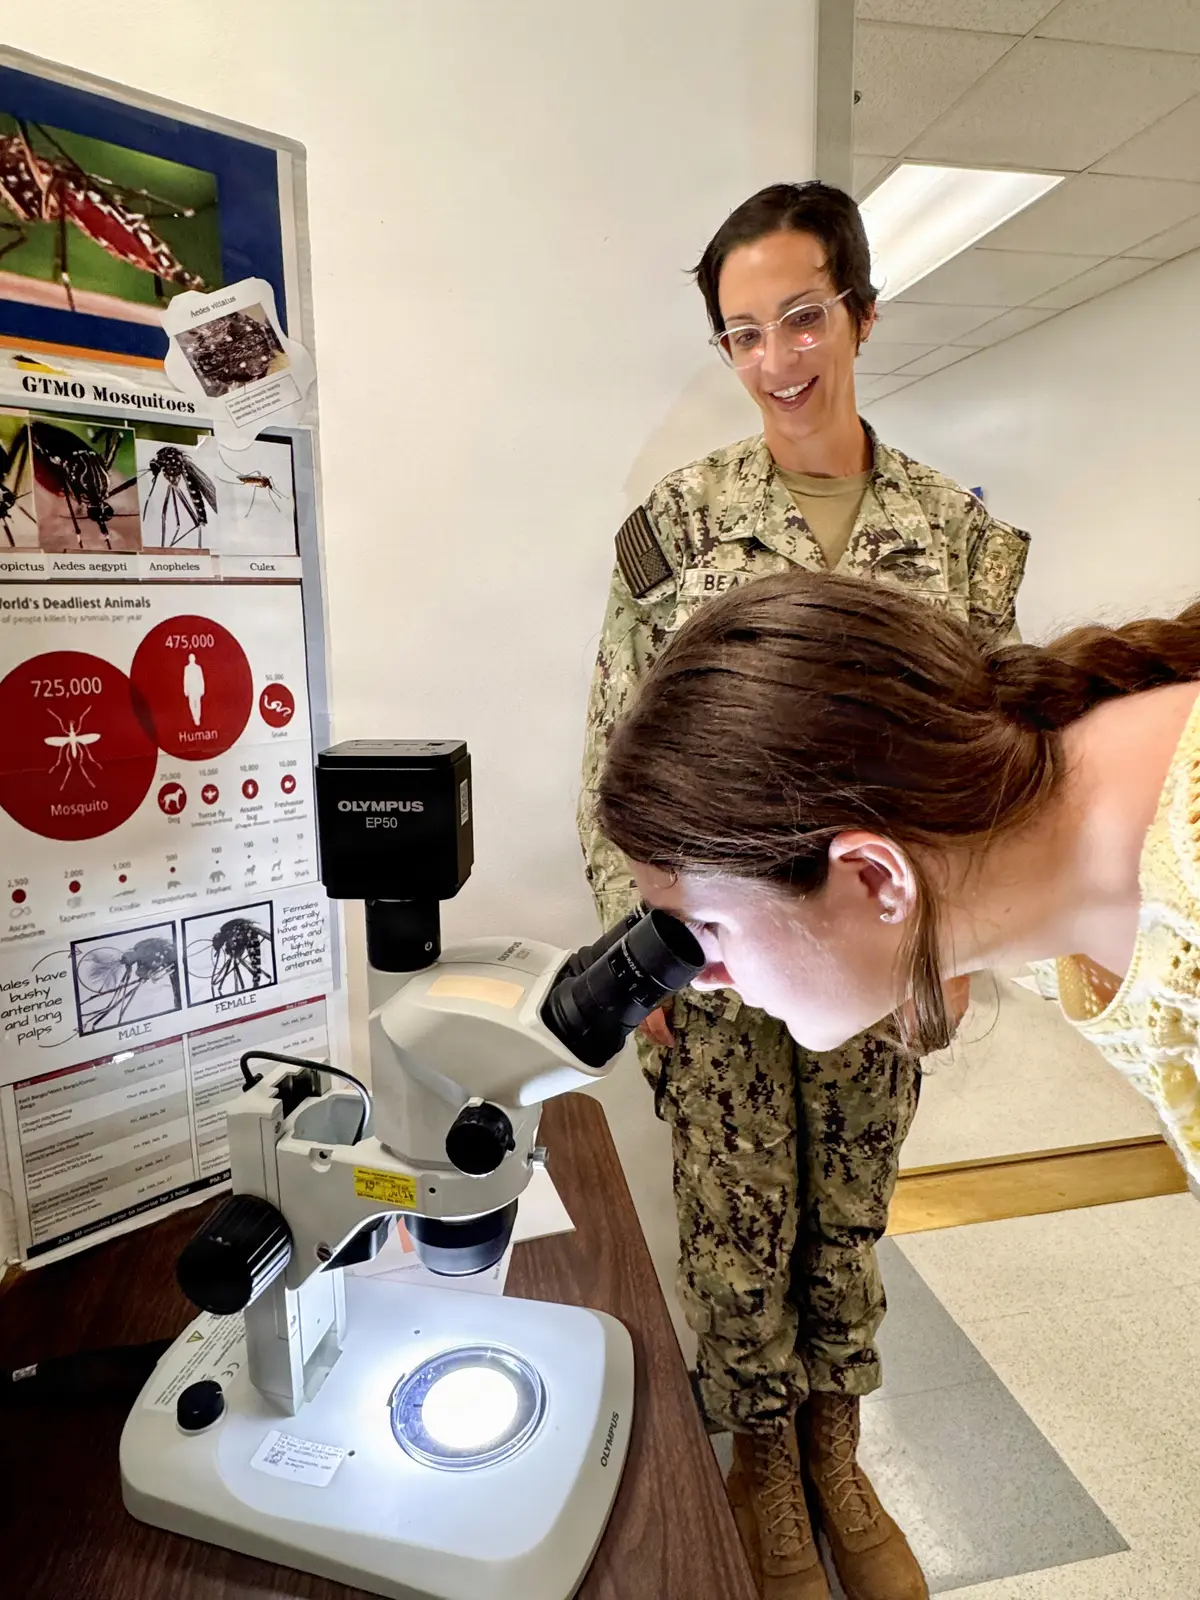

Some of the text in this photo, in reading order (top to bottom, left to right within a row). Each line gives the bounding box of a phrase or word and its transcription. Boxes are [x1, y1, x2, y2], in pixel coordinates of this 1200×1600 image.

[190, 305, 211, 318] Aedes
[22, 376, 195, 413] GTMO Mosquitoes
[53, 562, 127, 572] Aedes aegypti
[149, 562, 200, 572] Anopheles
[250, 563, 276, 571] Culex
[0, 596, 151, 609] orld's Deadliest Animals
[165, 634, 214, 649] 475,000
[31, 677, 102, 698] 725,000
[179, 729, 218, 743] Human
[51, 800, 108, 817] Mosquito
[337, 800, 424, 812] OLYMPUS
[366, 817, 398, 828] EP50
[283, 902, 318, 914] Females
[277, 918, 324, 934] have short
[282, 910, 320, 927] generally
[282, 926, 322, 946] palps and
[281, 944, 325, 962] feathered
[285, 957, 322, 971] antennae
[36, 970, 68, 984] have
[9, 987, 51, 1003] bushy
[0, 997, 62, 1019] antennae
[215, 994, 257, 1013] FEMALE
[5, 1011, 62, 1031] and long
[17, 1025, 52, 1045] palps
[118, 1022, 152, 1040] MALE
[600, 1411, 619, 1467] OLYMPUS
